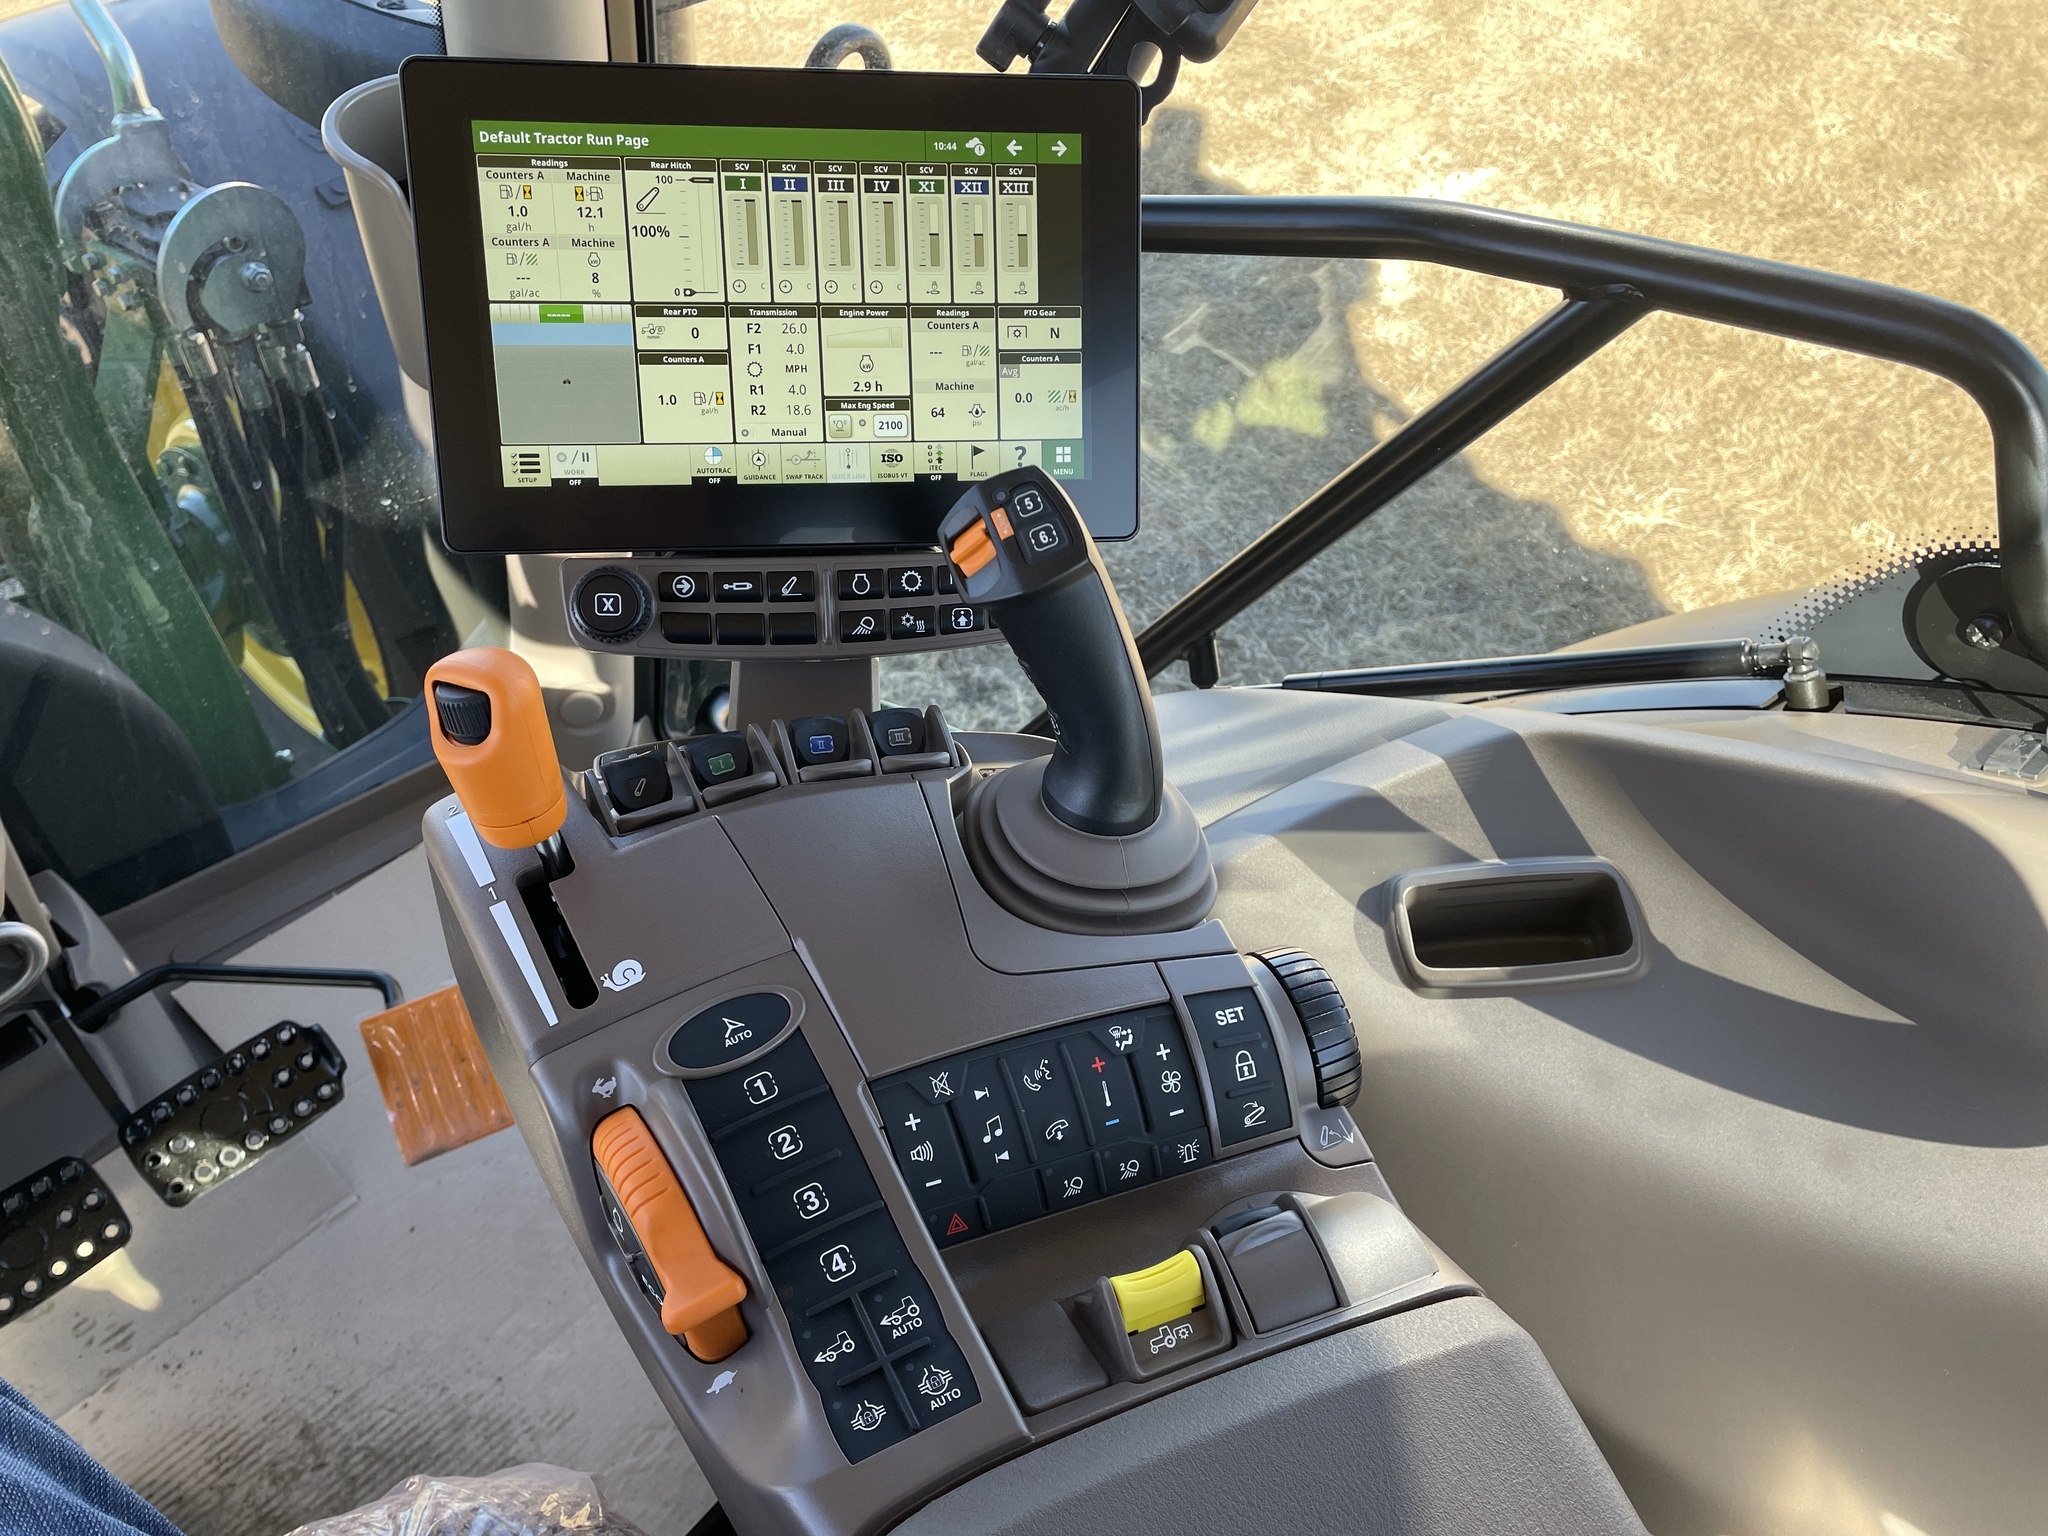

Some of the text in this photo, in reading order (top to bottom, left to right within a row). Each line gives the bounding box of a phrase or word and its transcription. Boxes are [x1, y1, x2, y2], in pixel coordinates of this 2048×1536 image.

[479, 131, 650, 149] Default Tractor Run Page
[933, 142, 957, 151] 10:44
[531, 159, 569, 169] Readings
[650, 161, 692, 170] Rear Hitch
[734, 163, 750, 171] SCV
[781, 164, 797, 172] SCV
[827, 165, 843, 173] SCV
[873, 165, 889, 173] SCV
[486, 170, 545, 180] Counters A
[919, 166, 934, 174] SCV
[964, 167, 979, 175] SCV
[566, 171, 611, 182] Machine
[655, 175, 673, 185] 100
[783, 179, 796, 190] II
[827, 180, 845, 191] III
[873, 181, 890, 192] IV
[918, 181, 935, 193] XI
[960, 182, 983, 193] XII
[1002, 182, 1029, 194] XIII
[508, 205, 528, 218] 1.0
[577, 206, 603, 219] 12.1
[506, 222, 532, 234] gal/h
[588, 223, 595, 232] h
[632, 225, 670, 238] 100%
[491, 237, 550, 247] Counters A
[571, 238, 615, 248] Machine
[592, 272, 599, 284] 8
[509, 288, 540, 300] gal/ac
[674, 287, 681, 297] 0
[663, 308, 698, 316] Rear PTO
[839, 309, 863, 318] Engine
[936, 309, 970, 318] Readings
[746, 323, 808, 335] F2 26.0
[927, 321, 980, 330] Counters A
[691, 327, 700, 339] 0
[1050, 327, 1060, 339] N
[748, 343, 805, 355] F1 4.0
[662, 356, 698, 364] Counters
[1021, 355, 1053, 363] Counters
[785, 365, 808, 373] MPH
[1002, 366, 1018, 378] Avg
[750, 384, 807, 396] R1 4.0
[853, 381, 883, 392] 2.9 h
[935, 382, 975, 391] Machine
[658, 394, 677, 406] 1.0
[1014, 392, 1033, 404] 0.0
[751, 405, 812, 416] R2 18.6
[858, 402, 871, 410] Eng
[873, 402, 895, 410] Speed
[930, 407, 946, 418] 64
[878, 421, 903, 430] 2100
[771, 428, 807, 437] Manual
[881, 454, 904, 463] ISO
[1024, 497, 1034, 510] 5
[602, 597, 615, 612] X
[447, 805, 459, 816] 2
[488, 887, 498, 900] 1
[1215, 1005, 1245, 1026] SET
[724, 1029, 753, 1048] AUTO
[753, 1078, 768, 1097] 1
[777, 1132, 796, 1153] 2
[1119, 1162, 1126, 1171] 2
[802, 1190, 820, 1211] 3
[832, 1252, 848, 1273] 4
[892, 1317, 923, 1340] AUTO
[930, 1388, 961, 1410] AUTO
